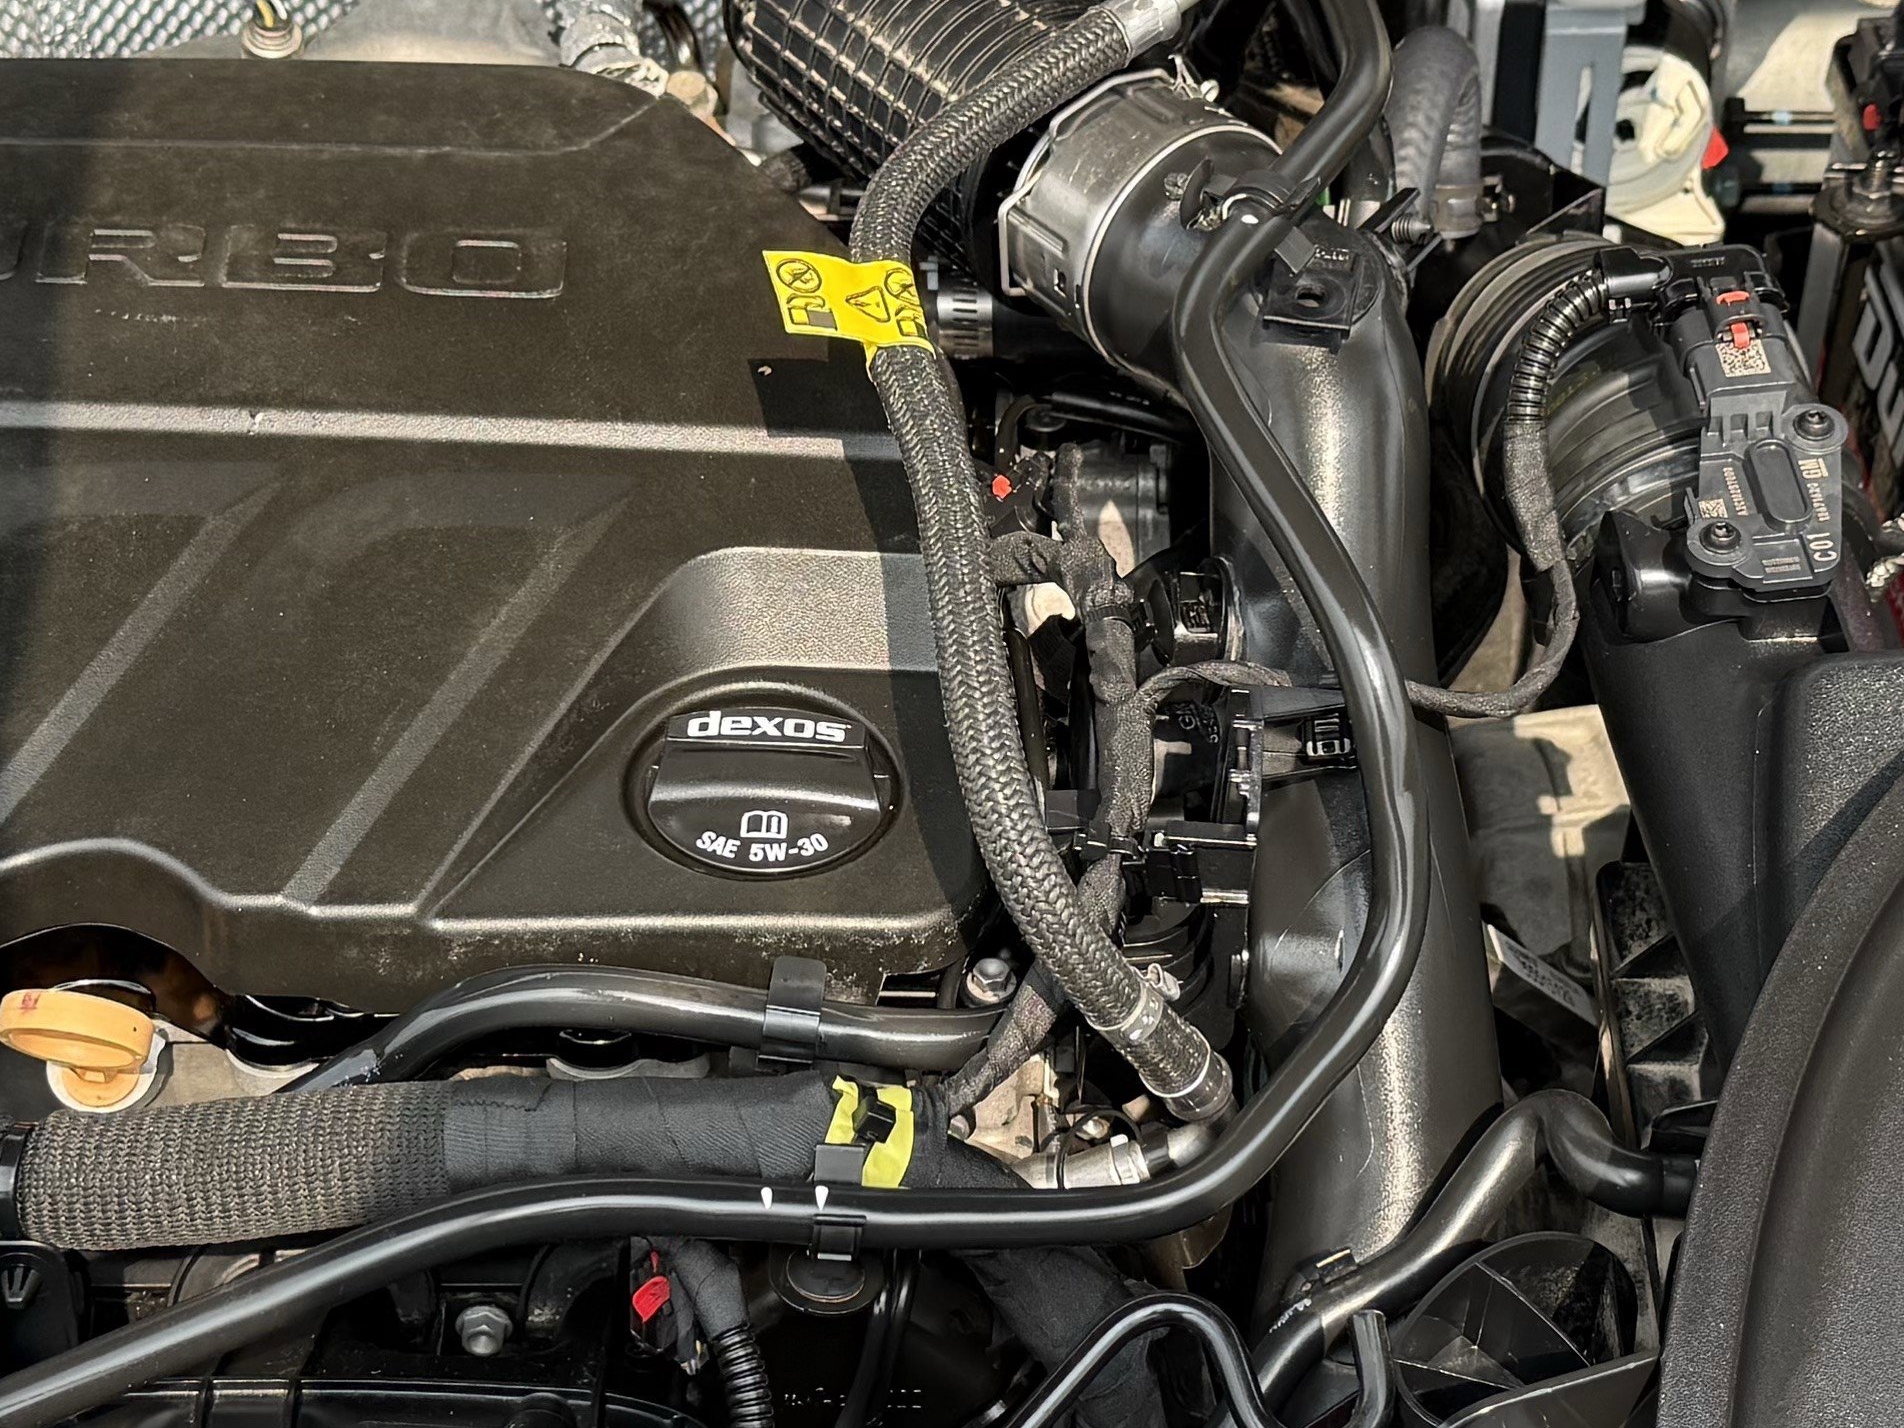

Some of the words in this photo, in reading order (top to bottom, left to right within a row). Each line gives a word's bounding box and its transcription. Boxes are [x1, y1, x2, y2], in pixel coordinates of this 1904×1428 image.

[687, 711, 846, 742] dexos
[696, 831, 741, 859] SAE
[749, 833, 829, 862] 5W-30
